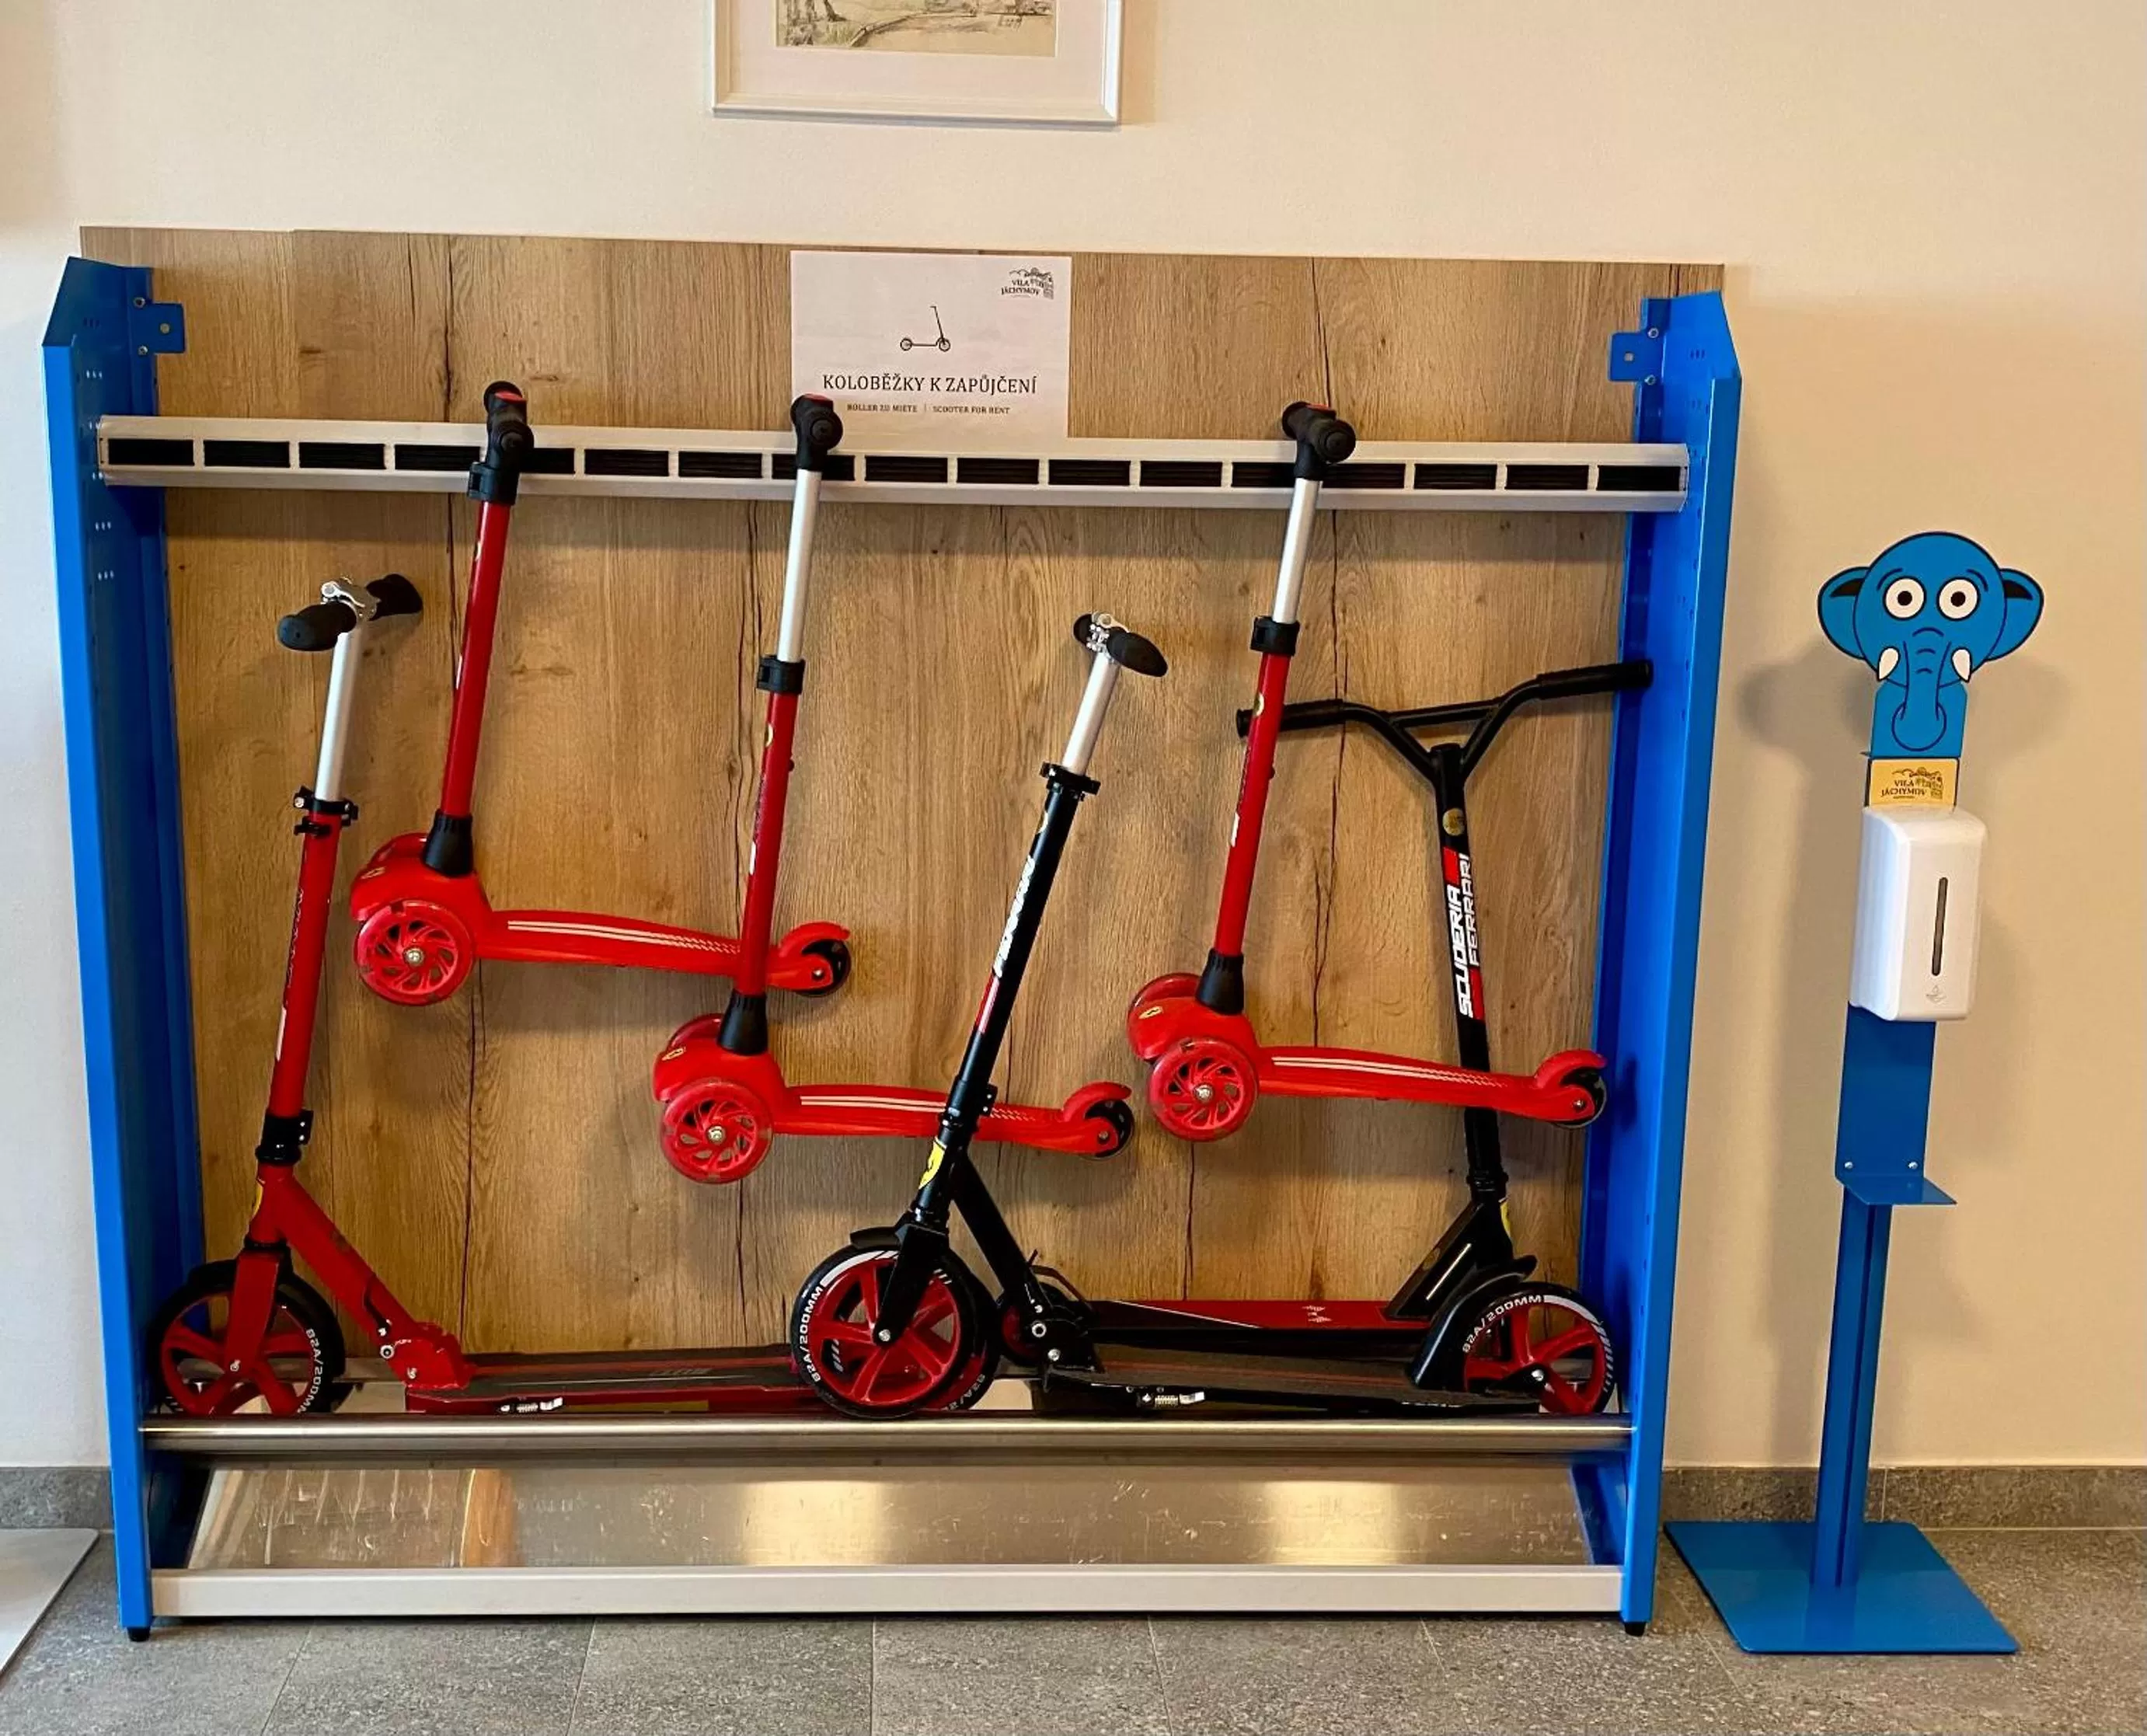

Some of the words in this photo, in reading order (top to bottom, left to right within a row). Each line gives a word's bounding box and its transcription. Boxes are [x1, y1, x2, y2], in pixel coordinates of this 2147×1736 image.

[823, 373, 925, 392] KOLOBĚŽKY
[930, 377, 941, 392] K
[946, 374, 1037, 396] ZAPŮJČENÍ
[847, 403, 878, 412] ROLLER
[893, 405, 918, 413] MIETE
[1459, 853, 1479, 967] FERRARI
[1447, 884, 1473, 1019] SCUDERIA
